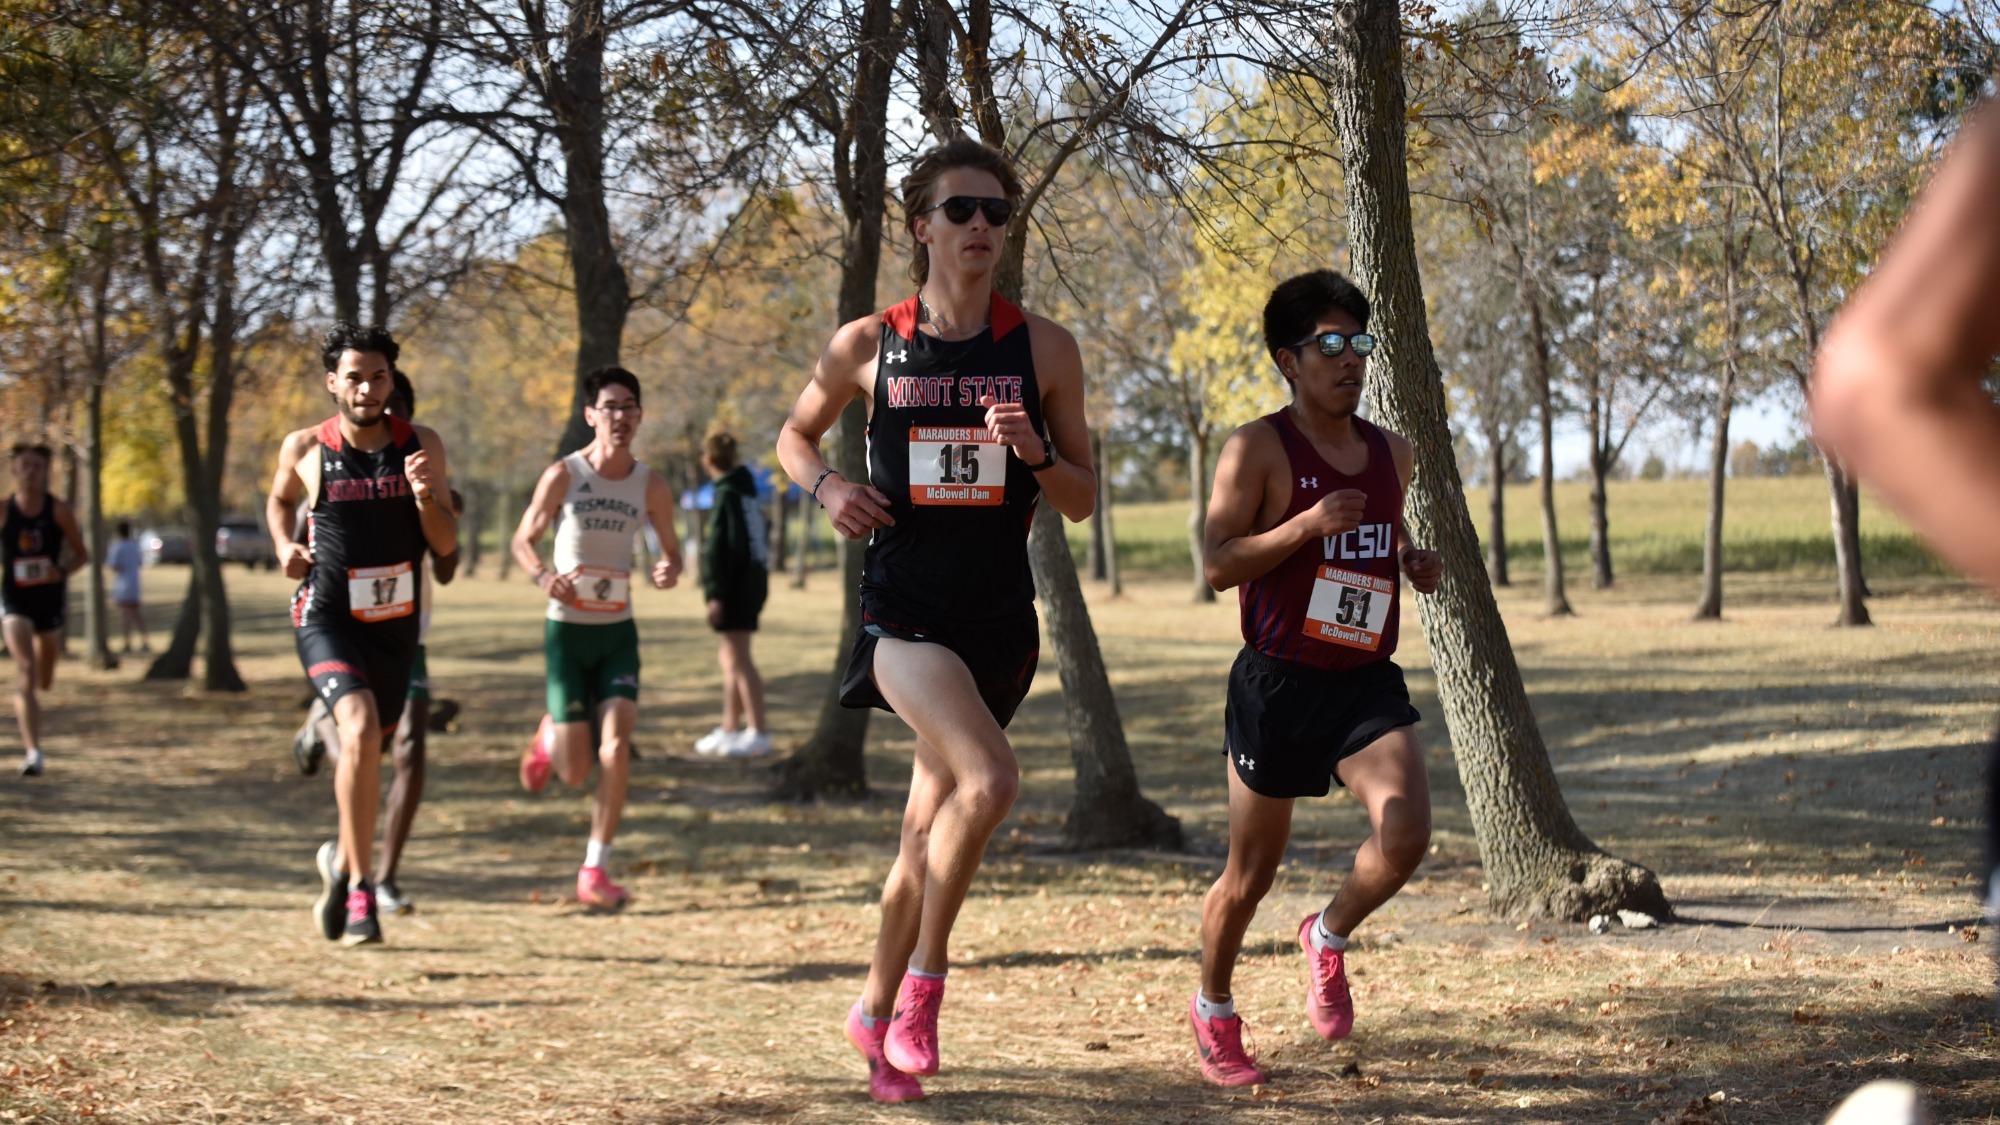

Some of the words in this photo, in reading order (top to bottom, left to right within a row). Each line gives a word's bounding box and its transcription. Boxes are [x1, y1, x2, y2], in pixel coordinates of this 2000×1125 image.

[888, 376, 954, 409] MINOT
[959, 376, 1023, 407] STATE
[918, 428, 971, 441] MARAUDERS
[974, 429, 997, 441] INVI
[940, 444, 980, 485] 15
[926, 487, 969, 500] McDowell
[971, 488, 990, 500] Dam
[583, 518, 626, 533] STATE
[1323, 523, 1392, 560] VCSU
[373, 577, 398, 606] 17
[1325, 567, 1372, 588] MARAUDERS
[1372, 578, 1392, 593] INVITE
[1335, 585, 1372, 629] 51
[1320, 623, 1359, 642] McDowell
[1359, 632, 1372, 645] Dam
